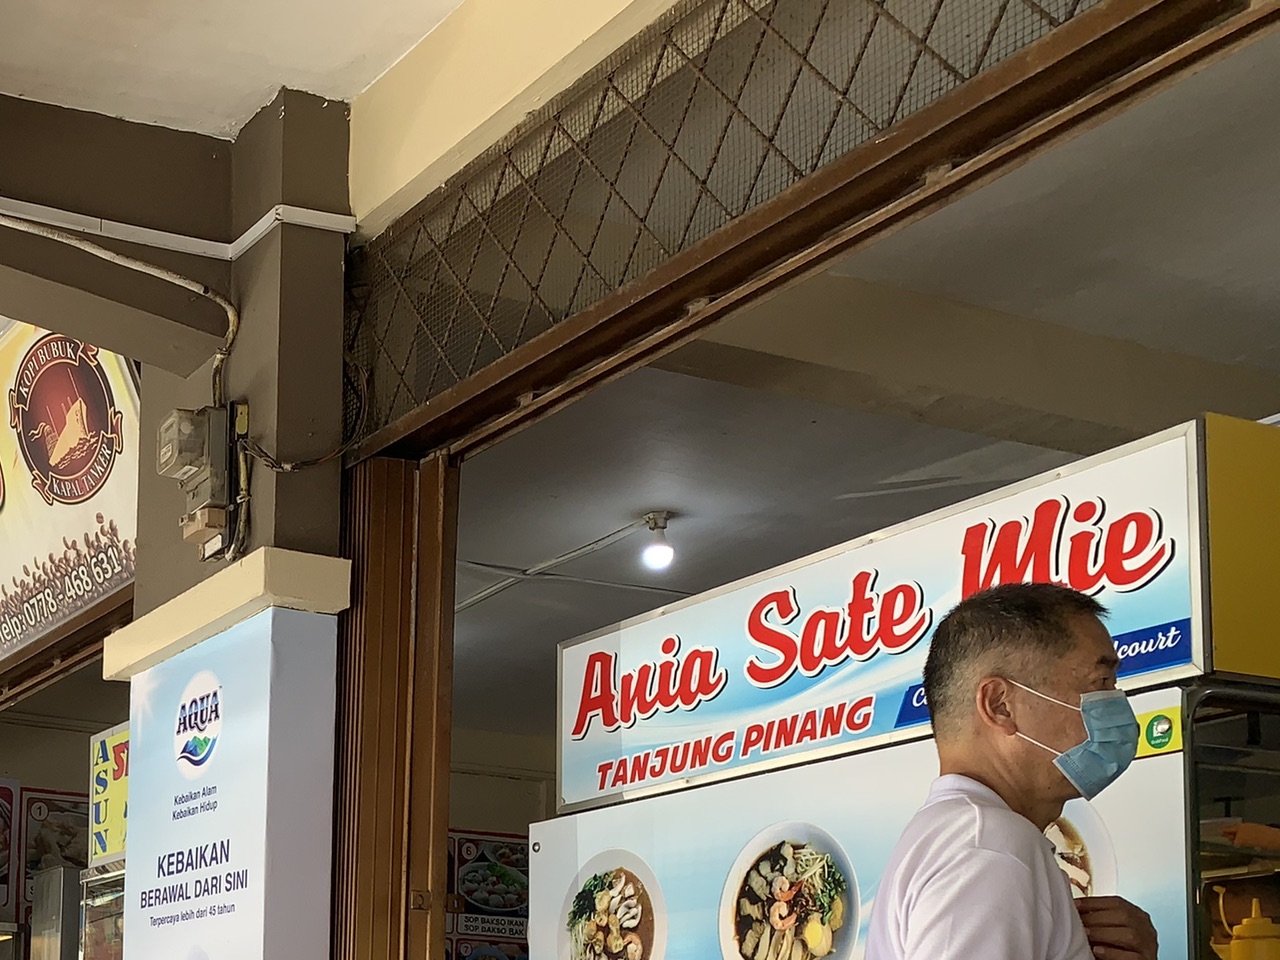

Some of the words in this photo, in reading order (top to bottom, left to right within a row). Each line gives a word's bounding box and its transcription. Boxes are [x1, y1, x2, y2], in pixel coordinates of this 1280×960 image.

[19, 359, 39, 399] KOPI
[37, 341, 76, 365] BUBUK
[51, 476, 84, 497] KAPAL
[82, 443, 112, 491] TANKER
[23, 589, 58, 626] 0778
[64, 567, 92, 602] 468
[90, 547, 122, 584] 631
[571, 634, 724, 739] Ania
[746, 570, 930, 686] Sate
[960, 496, 1173, 594] Mie
[176, 690, 220, 736] AQUA
[597, 730, 736, 791] TANJUNG
[740, 696, 876, 759] PINANG
[172, 805, 198, 821] Kebaikan
[200, 799, 218, 813] Hidup
[174, 790, 201, 806] Kebaikan
[202, 785, 217, 798] Alam
[157, 839, 230, 878] KEBAIKAN
[465, 846, 472, 856] 6
[140, 882, 191, 909] BERAWAL
[194, 875, 222, 899] DARI
[225, 869, 248, 892] SINI
[149, 912, 180, 928] Terpercaya
[180, 909, 195, 921] lebih
[196, 907, 208, 918] dari
[208, 905, 217, 916] 45
[217, 903, 236, 915] tahun
[464, 915, 480, 924] SOP
[481, 917, 507, 927] BAKSO
[464, 924, 480, 932] SOP
[481, 925, 507, 935] BAKSO
